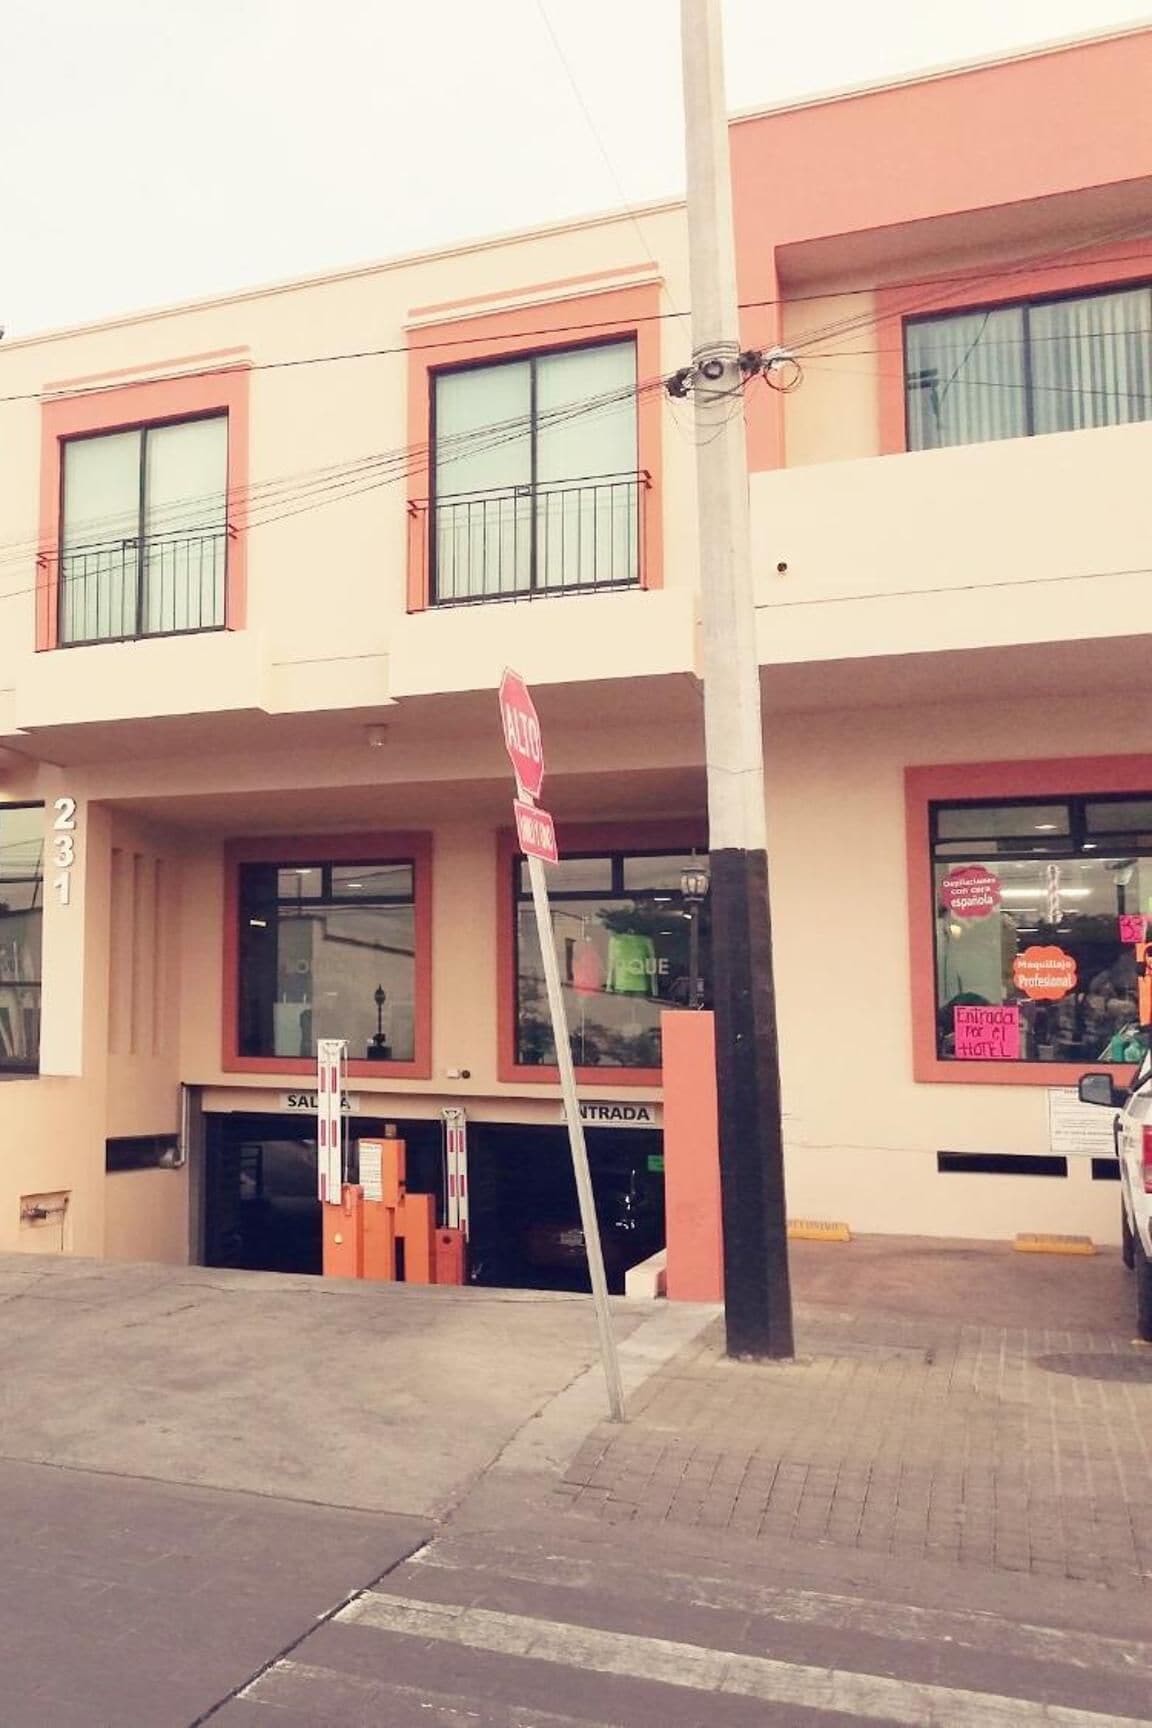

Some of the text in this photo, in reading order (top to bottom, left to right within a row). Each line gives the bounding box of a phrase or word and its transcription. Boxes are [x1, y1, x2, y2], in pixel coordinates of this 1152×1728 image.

[505, 703, 539, 763] ALTO
[53, 798, 77, 905] 231
[950, 893, 994, 910] española
[1017, 972, 1072, 988] Profesional
[957, 1007, 1016, 1025] Entrada
[992, 1026, 1005, 1042] el
[957, 1041, 1012, 1057] HOTEL
[287, 1094, 351, 1110] SALA
[570, 1105, 651, 1121] NTRADA
